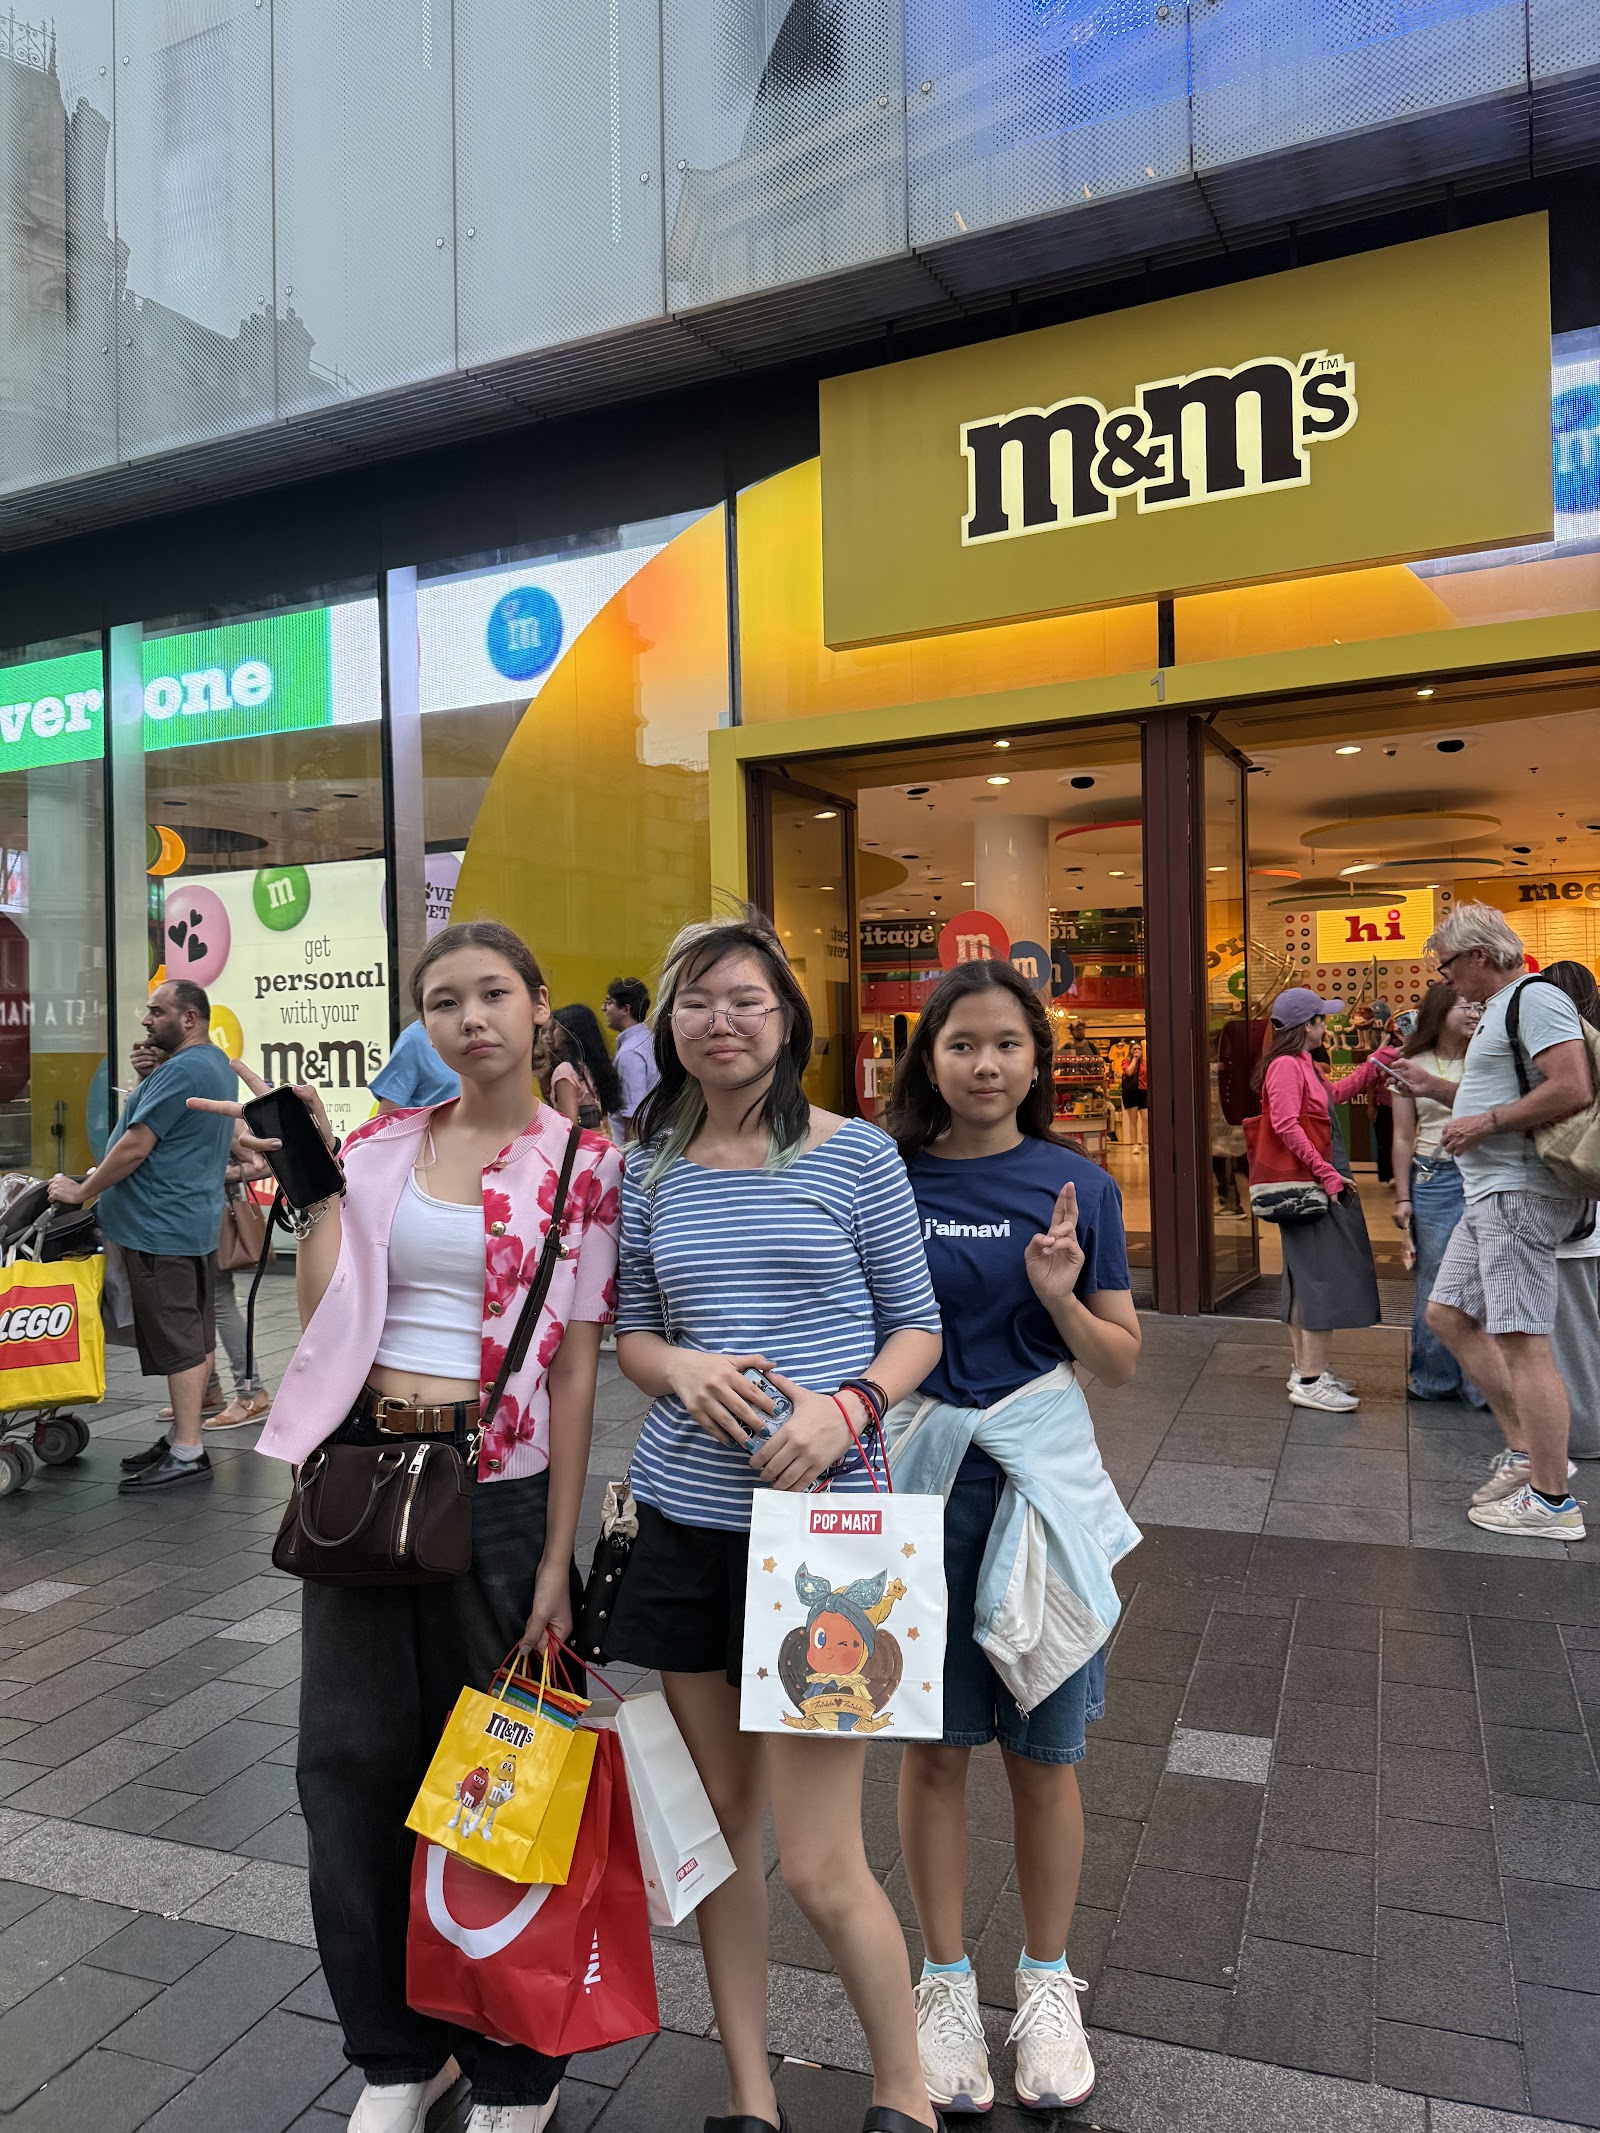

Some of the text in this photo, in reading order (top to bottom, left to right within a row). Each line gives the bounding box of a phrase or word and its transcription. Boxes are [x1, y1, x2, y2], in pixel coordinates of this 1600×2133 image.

[266, 877, 297, 909] m
[426, 905, 450, 919] ET
[1345, 909, 1406, 943] hi
[305, 935, 331, 964] get
[255, 962, 386, 999] personal
[280, 998, 359, 1030] with your
[923, 1218, 1011, 1241] j'aimavi
[813, 1513, 878, 1531] POP MART
